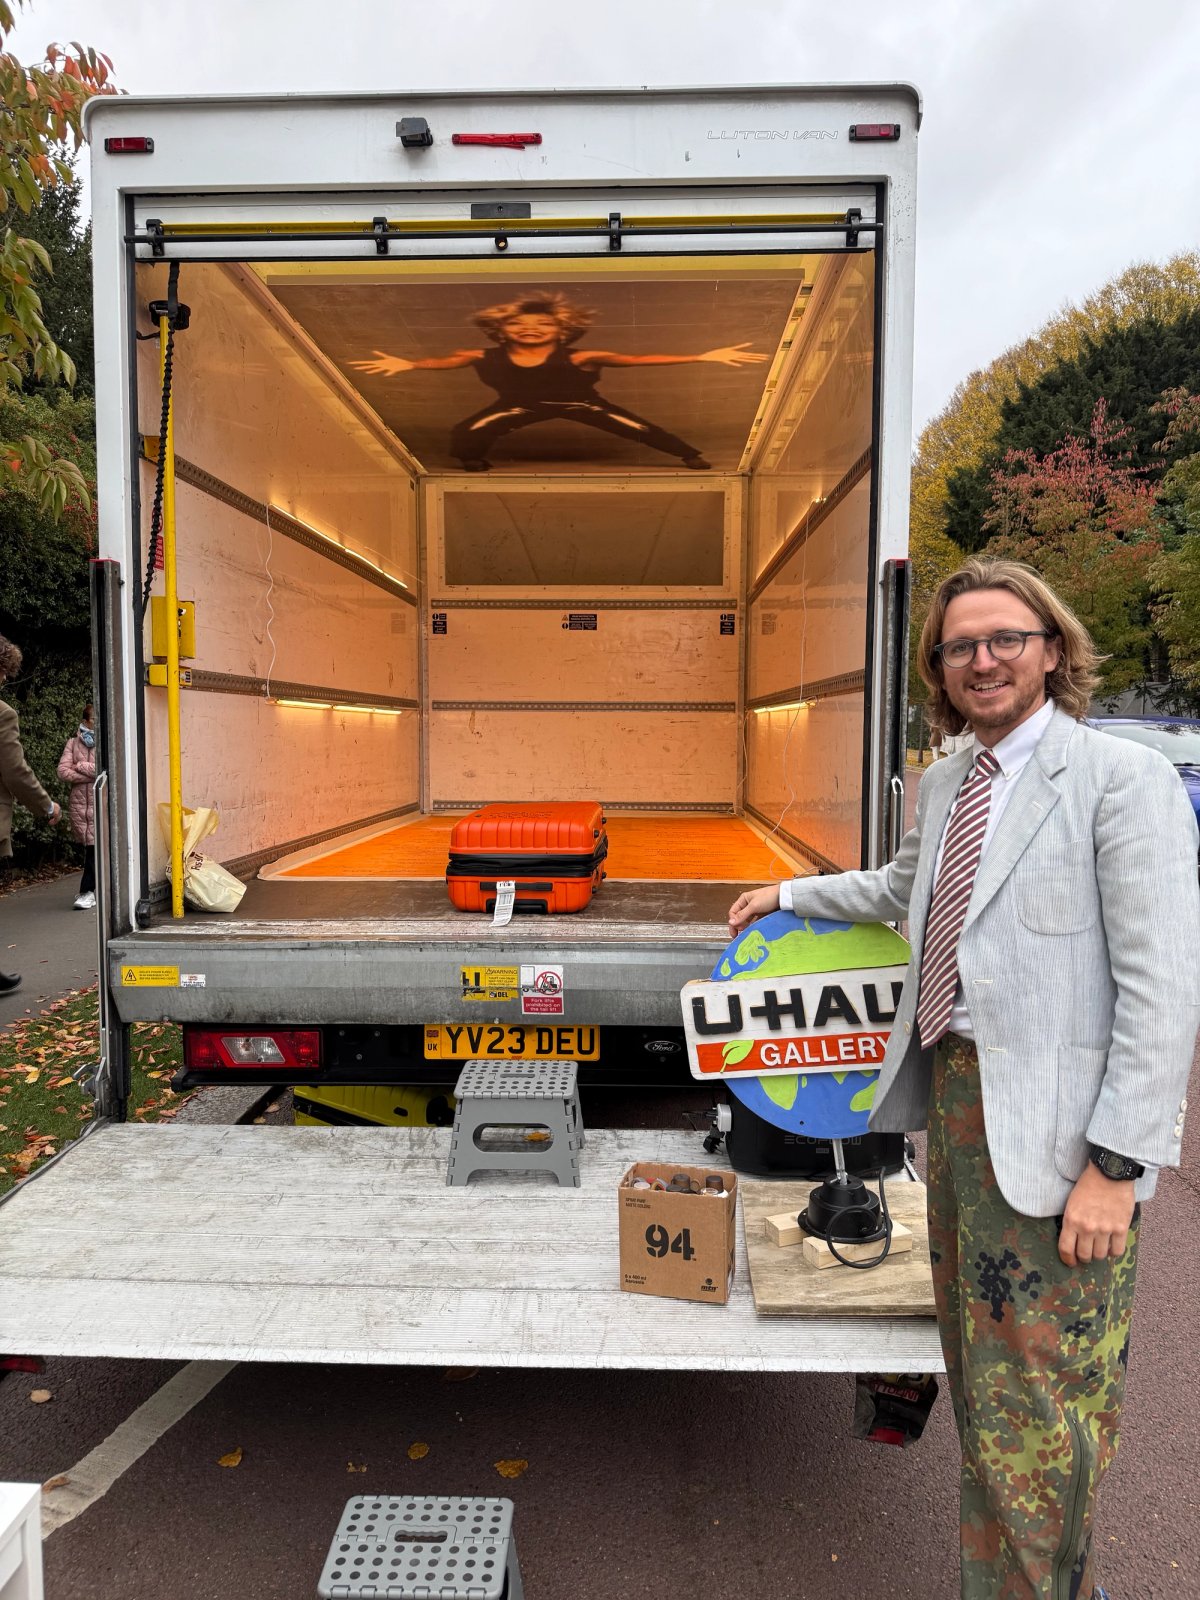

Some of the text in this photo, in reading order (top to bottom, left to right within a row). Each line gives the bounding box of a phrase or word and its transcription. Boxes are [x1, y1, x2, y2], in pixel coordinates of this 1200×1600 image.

[707, 130, 839, 140] LUTON VAN
[427, 1043, 438, 1052] UK
[446, 1026, 595, 1055] YV23 DEU
[645, 1223, 695, 1261] 94
